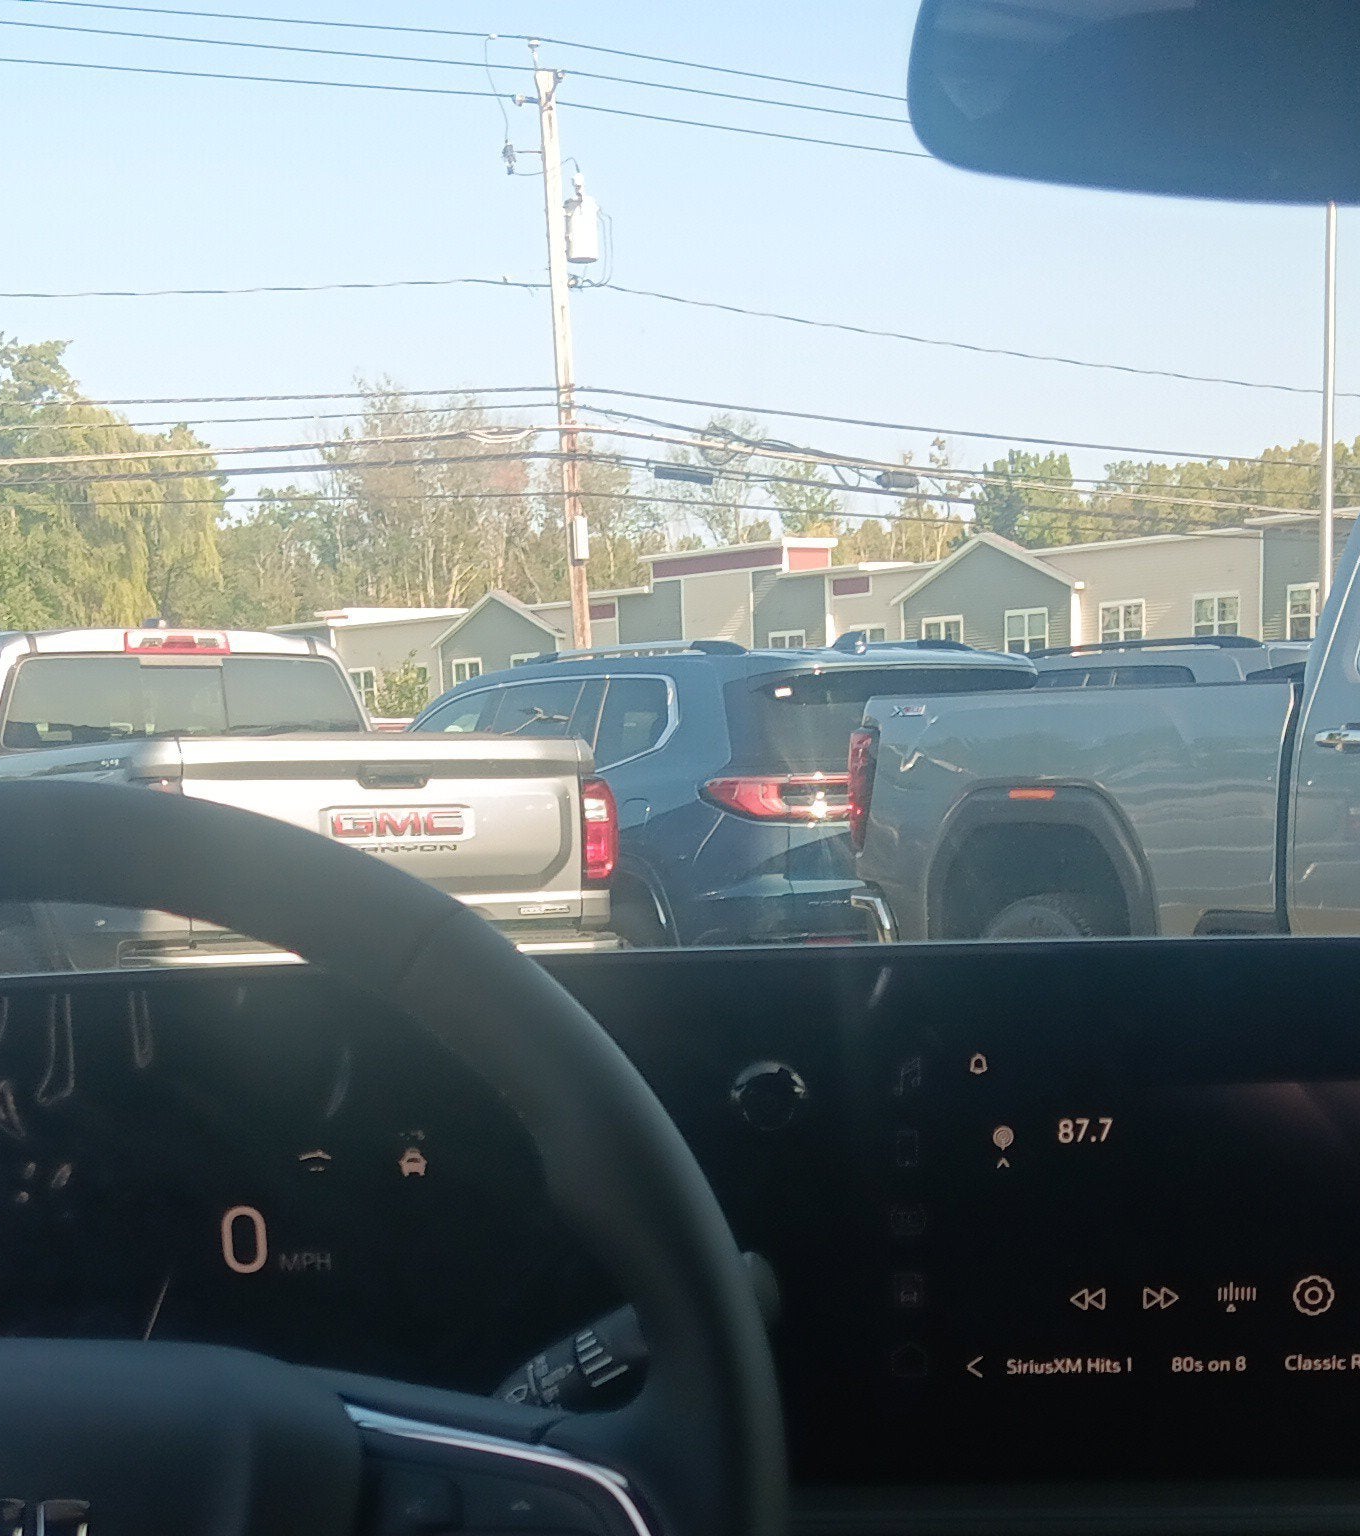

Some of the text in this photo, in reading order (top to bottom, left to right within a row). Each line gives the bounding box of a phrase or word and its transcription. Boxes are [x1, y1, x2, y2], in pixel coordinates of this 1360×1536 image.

[331, 811, 464, 838] GMC
[360, 844, 458, 853] ANYON
[1058, 1117, 1114, 1144] 87.7
[221, 1205, 334, 1274] 0 MPH
[1006, 1357, 1082, 1375] SiriusXM
[1086, 1357, 1122, 1374] Hits
[1171, 1355, 1247, 1373] 80s on 8
[1284, 1354, 1346, 1371] Classic
